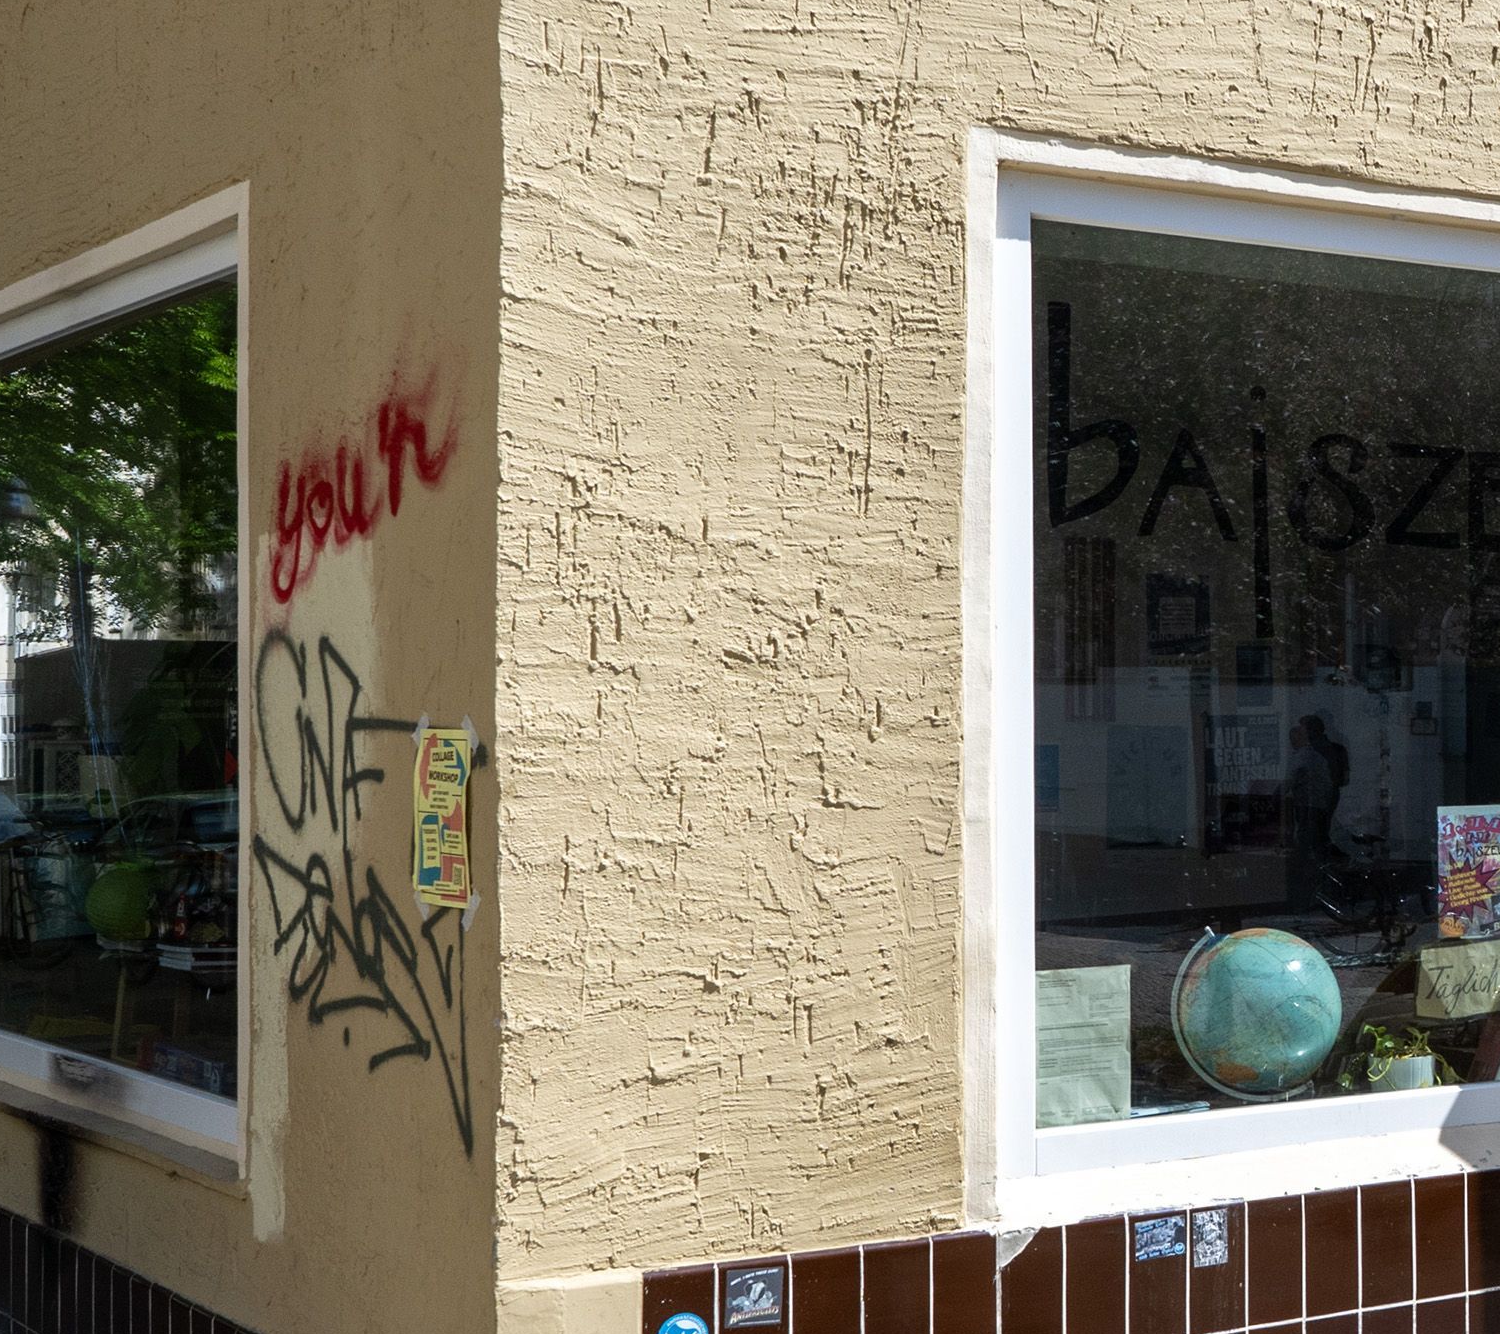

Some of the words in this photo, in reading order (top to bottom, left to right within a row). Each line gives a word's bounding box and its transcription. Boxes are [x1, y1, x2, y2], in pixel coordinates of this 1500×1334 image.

[1204, 727, 1246, 748] LAUT
[432, 751, 454, 762] COLLAGE
[1214, 747, 1261, 767] GEGEN
[428, 770, 458, 783] WORKSHOP
[1426, 958, 1499, 1015] Täglich
